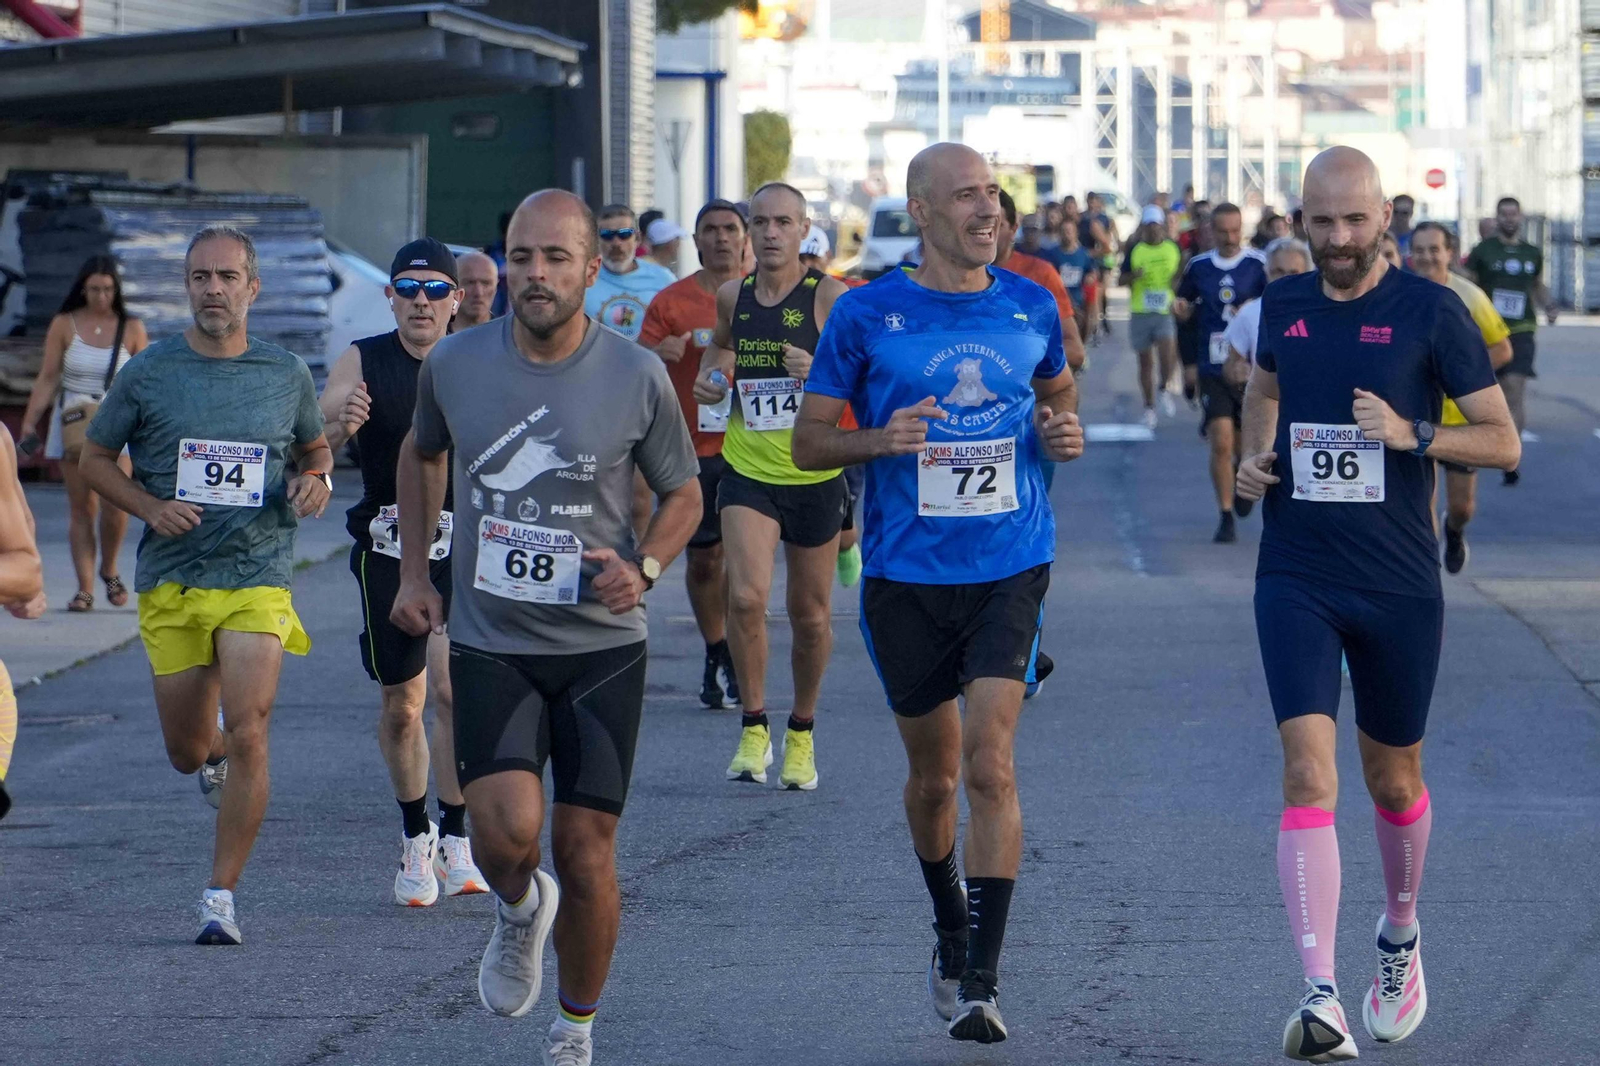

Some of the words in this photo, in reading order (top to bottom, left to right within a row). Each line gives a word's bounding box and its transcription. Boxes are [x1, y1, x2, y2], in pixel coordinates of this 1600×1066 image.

[737, 354, 777, 367] ARMEN
[955, 343, 1013, 375] VETERINARIA
[757, 381, 783, 390] ALFONSO
[527, 405, 550, 423] 10K
[751, 394, 798, 416] 114
[1315, 430, 1353, 441] ALFONSO
[209, 445, 242, 455] ALFONSO
[577, 454, 596, 463] ILLA
[924, 446, 952, 458] 10KMS
[954, 445, 993, 458] ALFONSO
[994, 442, 1013, 455] MORO
[204, 462, 245, 488] 94
[556, 470, 594, 481] AROUSA
[1312, 450, 1360, 480] 96
[952, 465, 997, 495] 72
[484, 520, 509, 536] 10KMS
[511, 527, 552, 544] ALFONSO
[554, 535, 577, 545] MOR
[505, 549, 555, 583] 68
[1403, 838, 1412, 891] COMPRESSPORT
[1297, 851, 1310, 930] COMPRESSPORT
